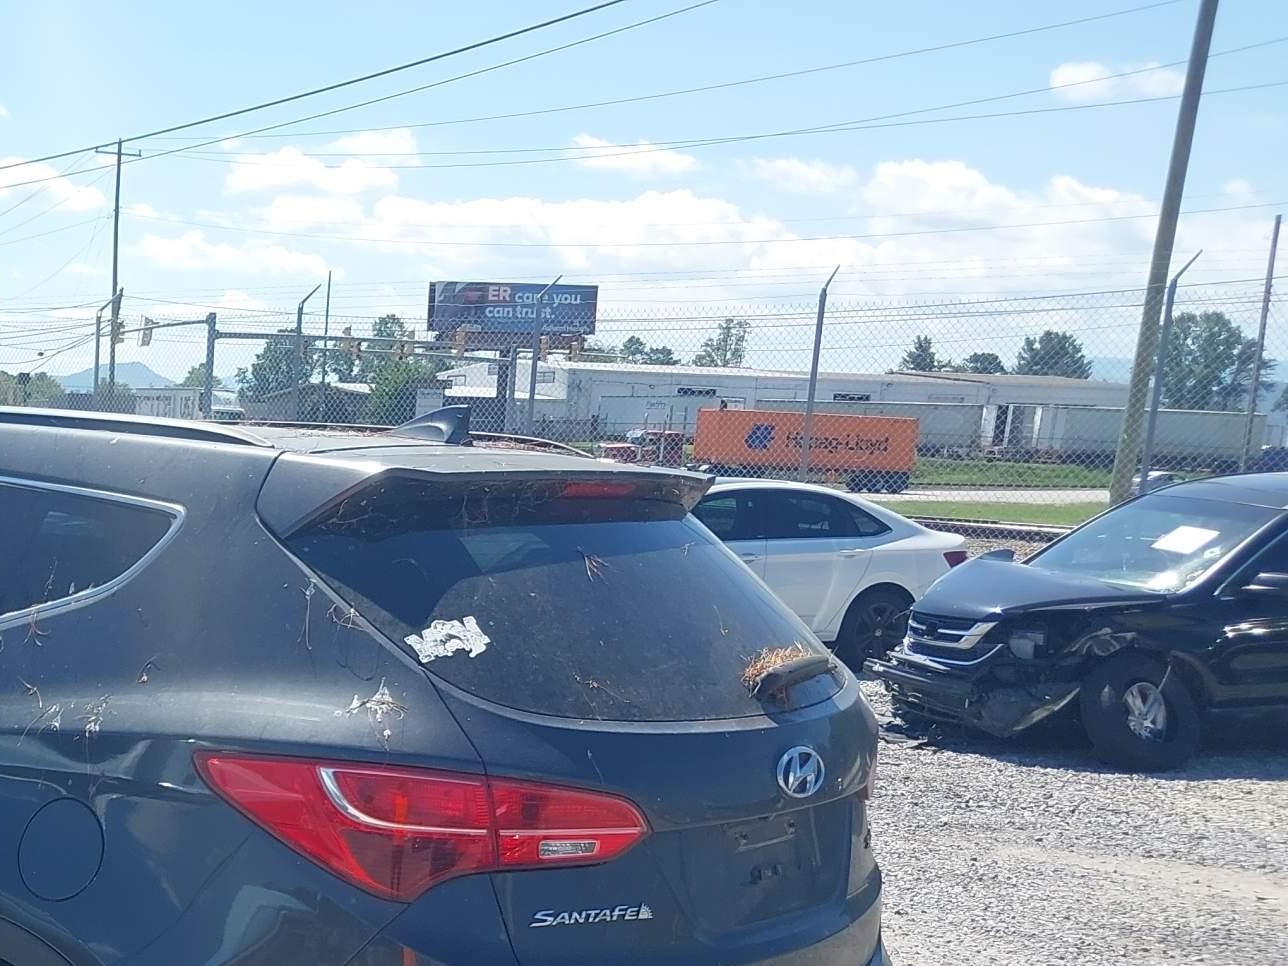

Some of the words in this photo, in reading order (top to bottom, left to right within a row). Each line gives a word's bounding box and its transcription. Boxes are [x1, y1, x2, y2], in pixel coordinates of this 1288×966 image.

[488, 286, 511, 301] ER
[553, 293, 581, 307] you
[486, 306, 512, 318] can
